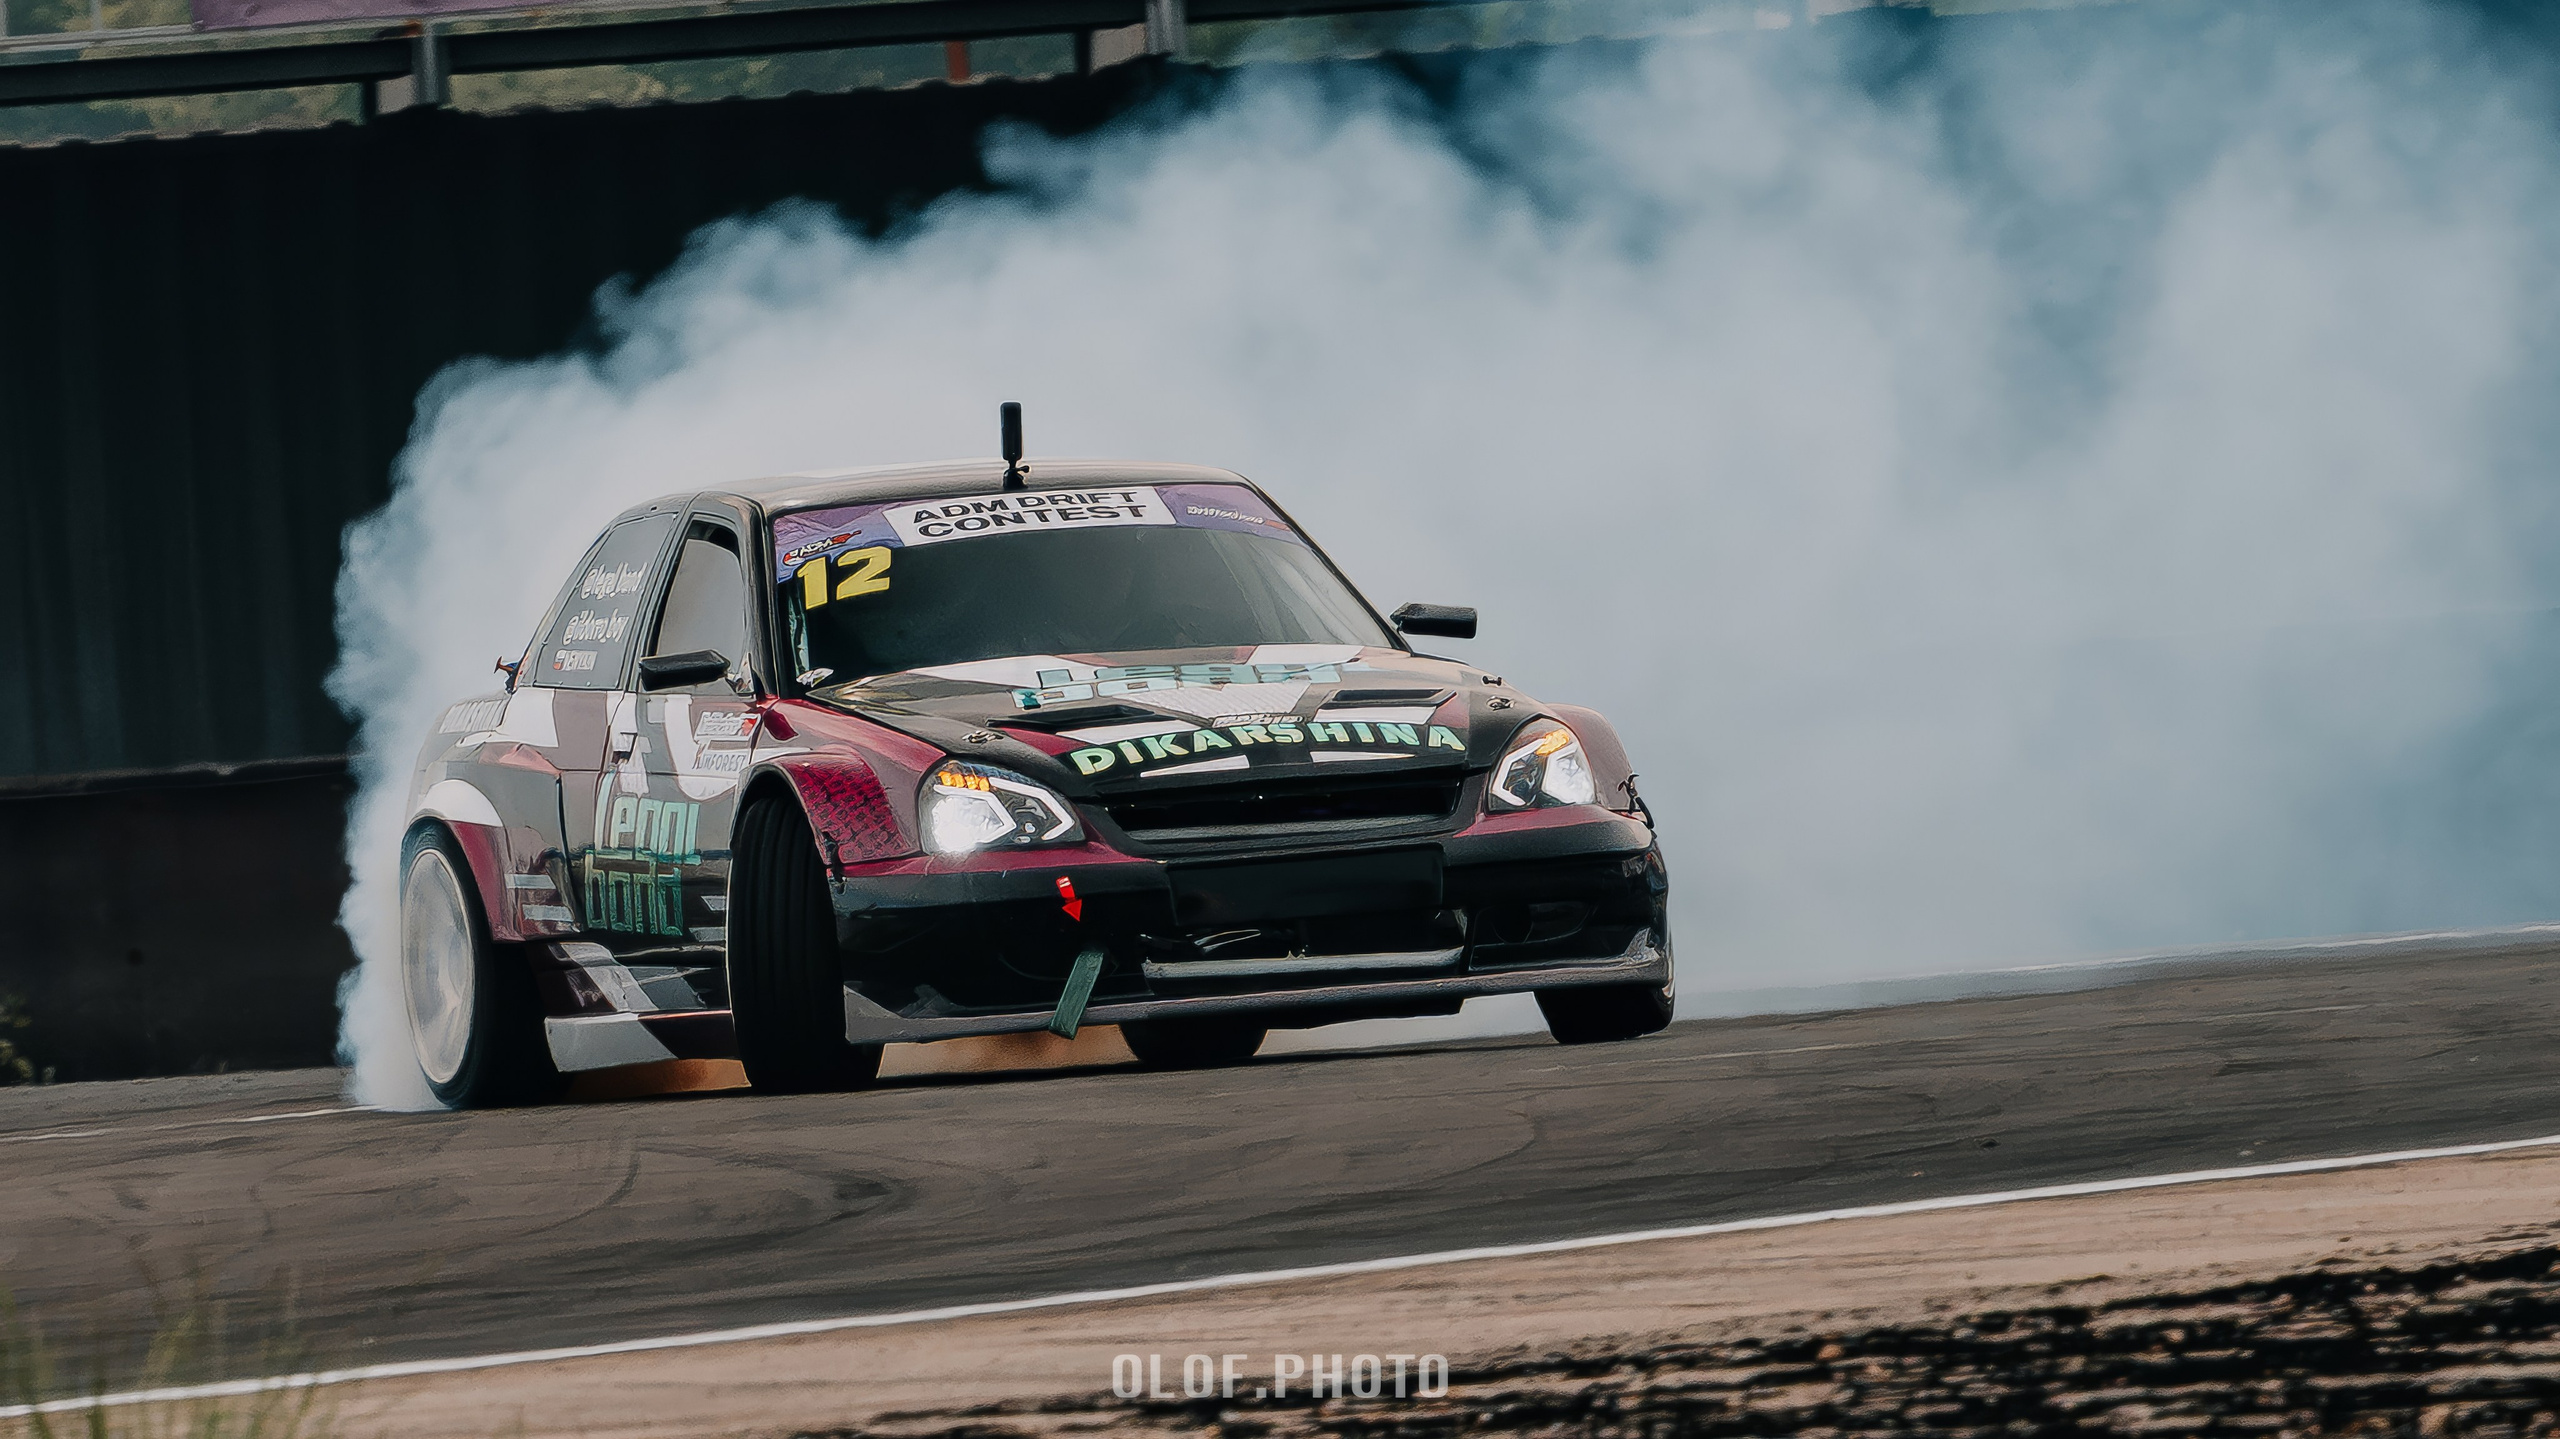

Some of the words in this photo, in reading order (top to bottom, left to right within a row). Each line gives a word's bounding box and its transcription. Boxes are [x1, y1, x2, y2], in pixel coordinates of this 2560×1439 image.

[912, 498, 1011, 524] ADM
[1015, 491, 1138, 509] DRIFT
[918, 504, 1147, 538] CONTEST
[796, 545, 892, 611] 12
[1069, 722, 1467, 776] DIKARSHINA
